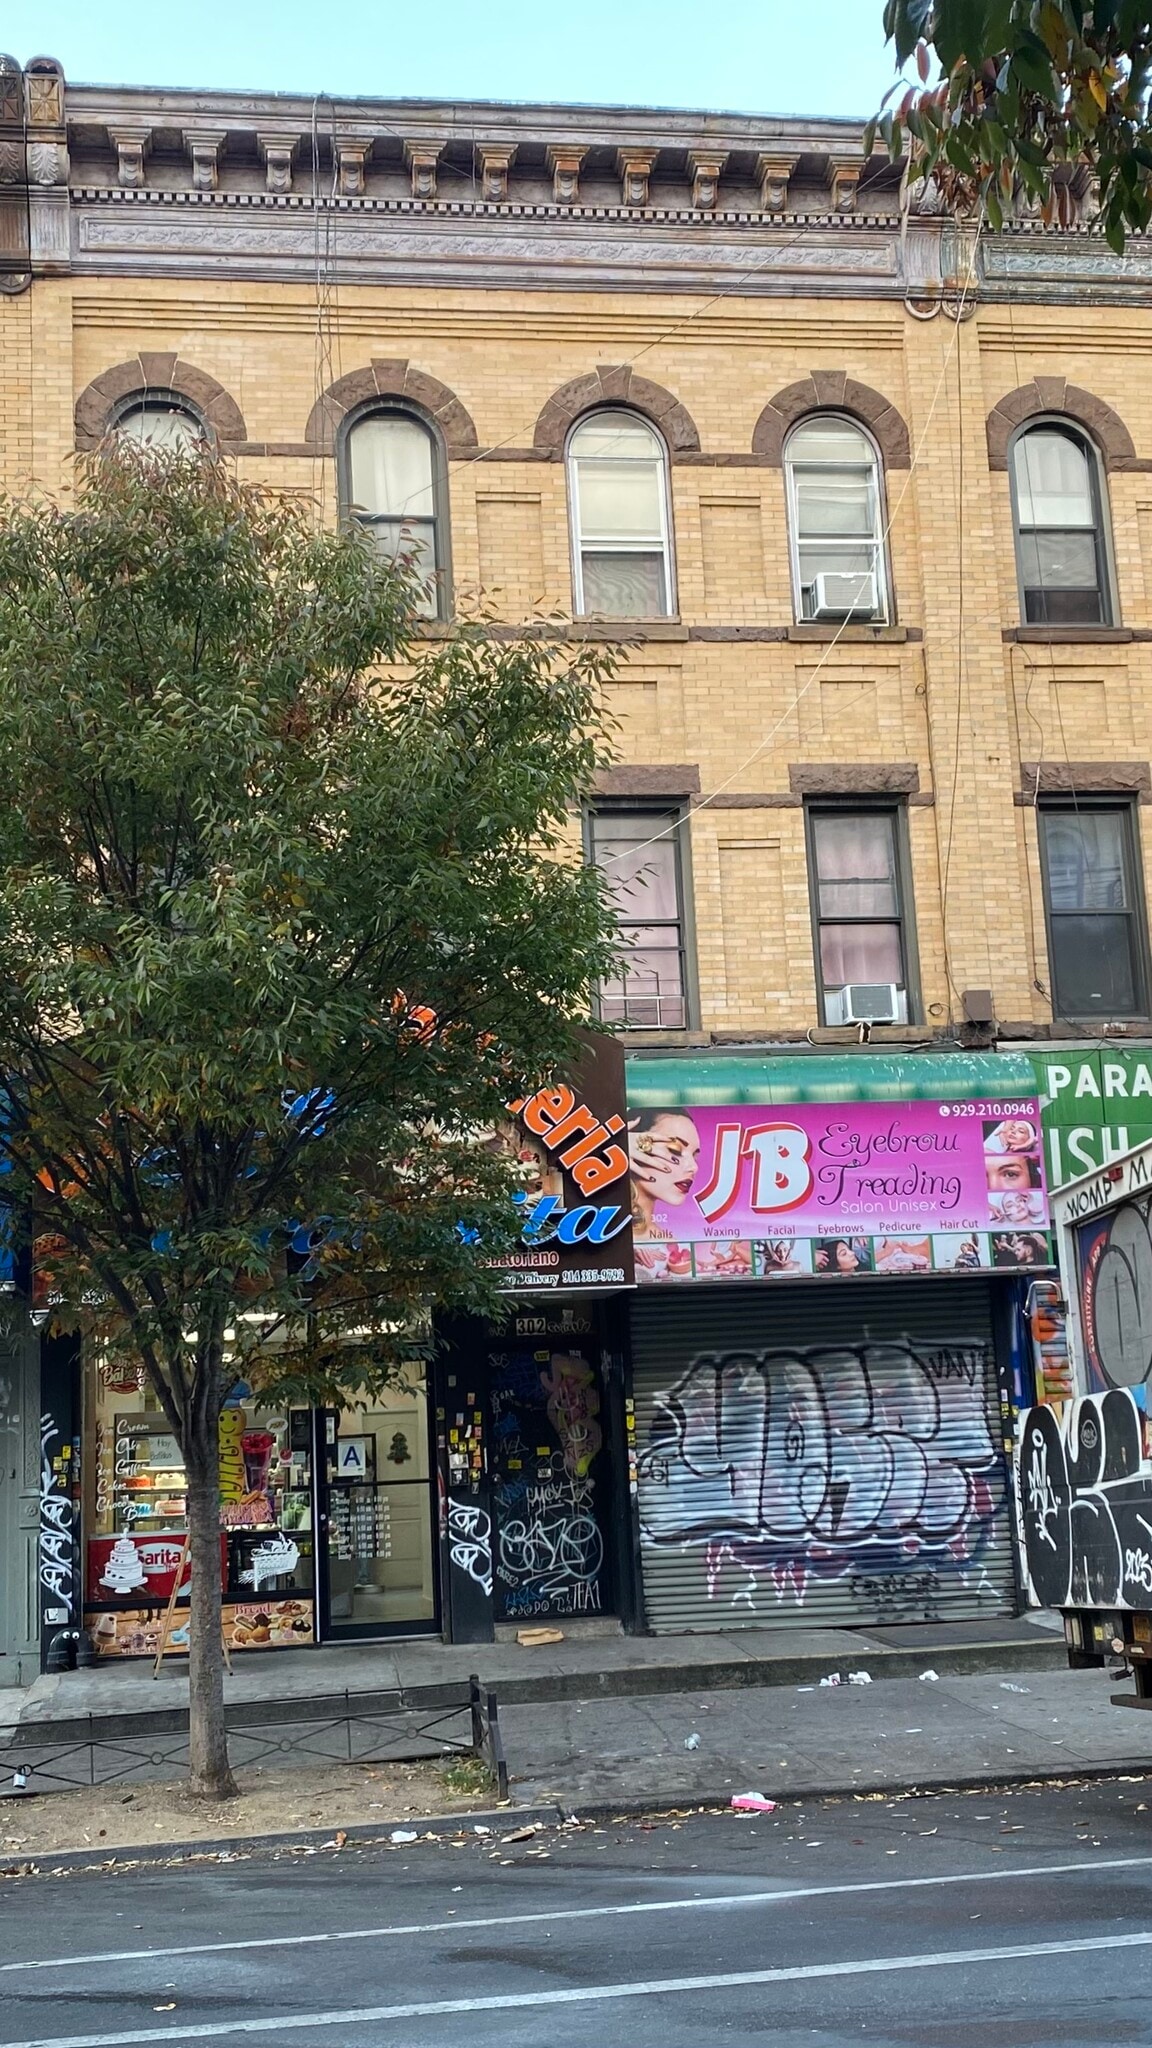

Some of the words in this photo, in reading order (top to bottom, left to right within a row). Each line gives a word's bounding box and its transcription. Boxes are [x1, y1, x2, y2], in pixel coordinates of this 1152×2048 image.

[952, 1103, 1034, 1118] 929.210.0946
[818, 1121, 961, 1167] Eyebrow
[693, 1121, 814, 1224] JB
[817, 1158, 962, 1210] Treading
[840, 1199, 884, 1214] Salon
[889, 1198, 938, 1213] Unisex
[651, 1213, 668, 1223] 302
[940, 1219, 960, 1230] Hair
[962, 1219, 979, 1229] Cut
[649, 1227, 673, 1239] Nails
[704, 1226, 740, 1238] Waxing
[768, 1225, 796, 1235] Facial
[818, 1222, 864, 1234] Eyebrows
[879, 1220, 922, 1232] Pedicure
[562, 1269, 580, 1284] 914
[581, 1268, 625, 1283] 335-9792
[517, 1318, 545, 1335] 302
[116, 1418, 149, 1435] Cream
[343, 1446, 361, 1467] A
[235, 1603, 272, 1615] Bread
